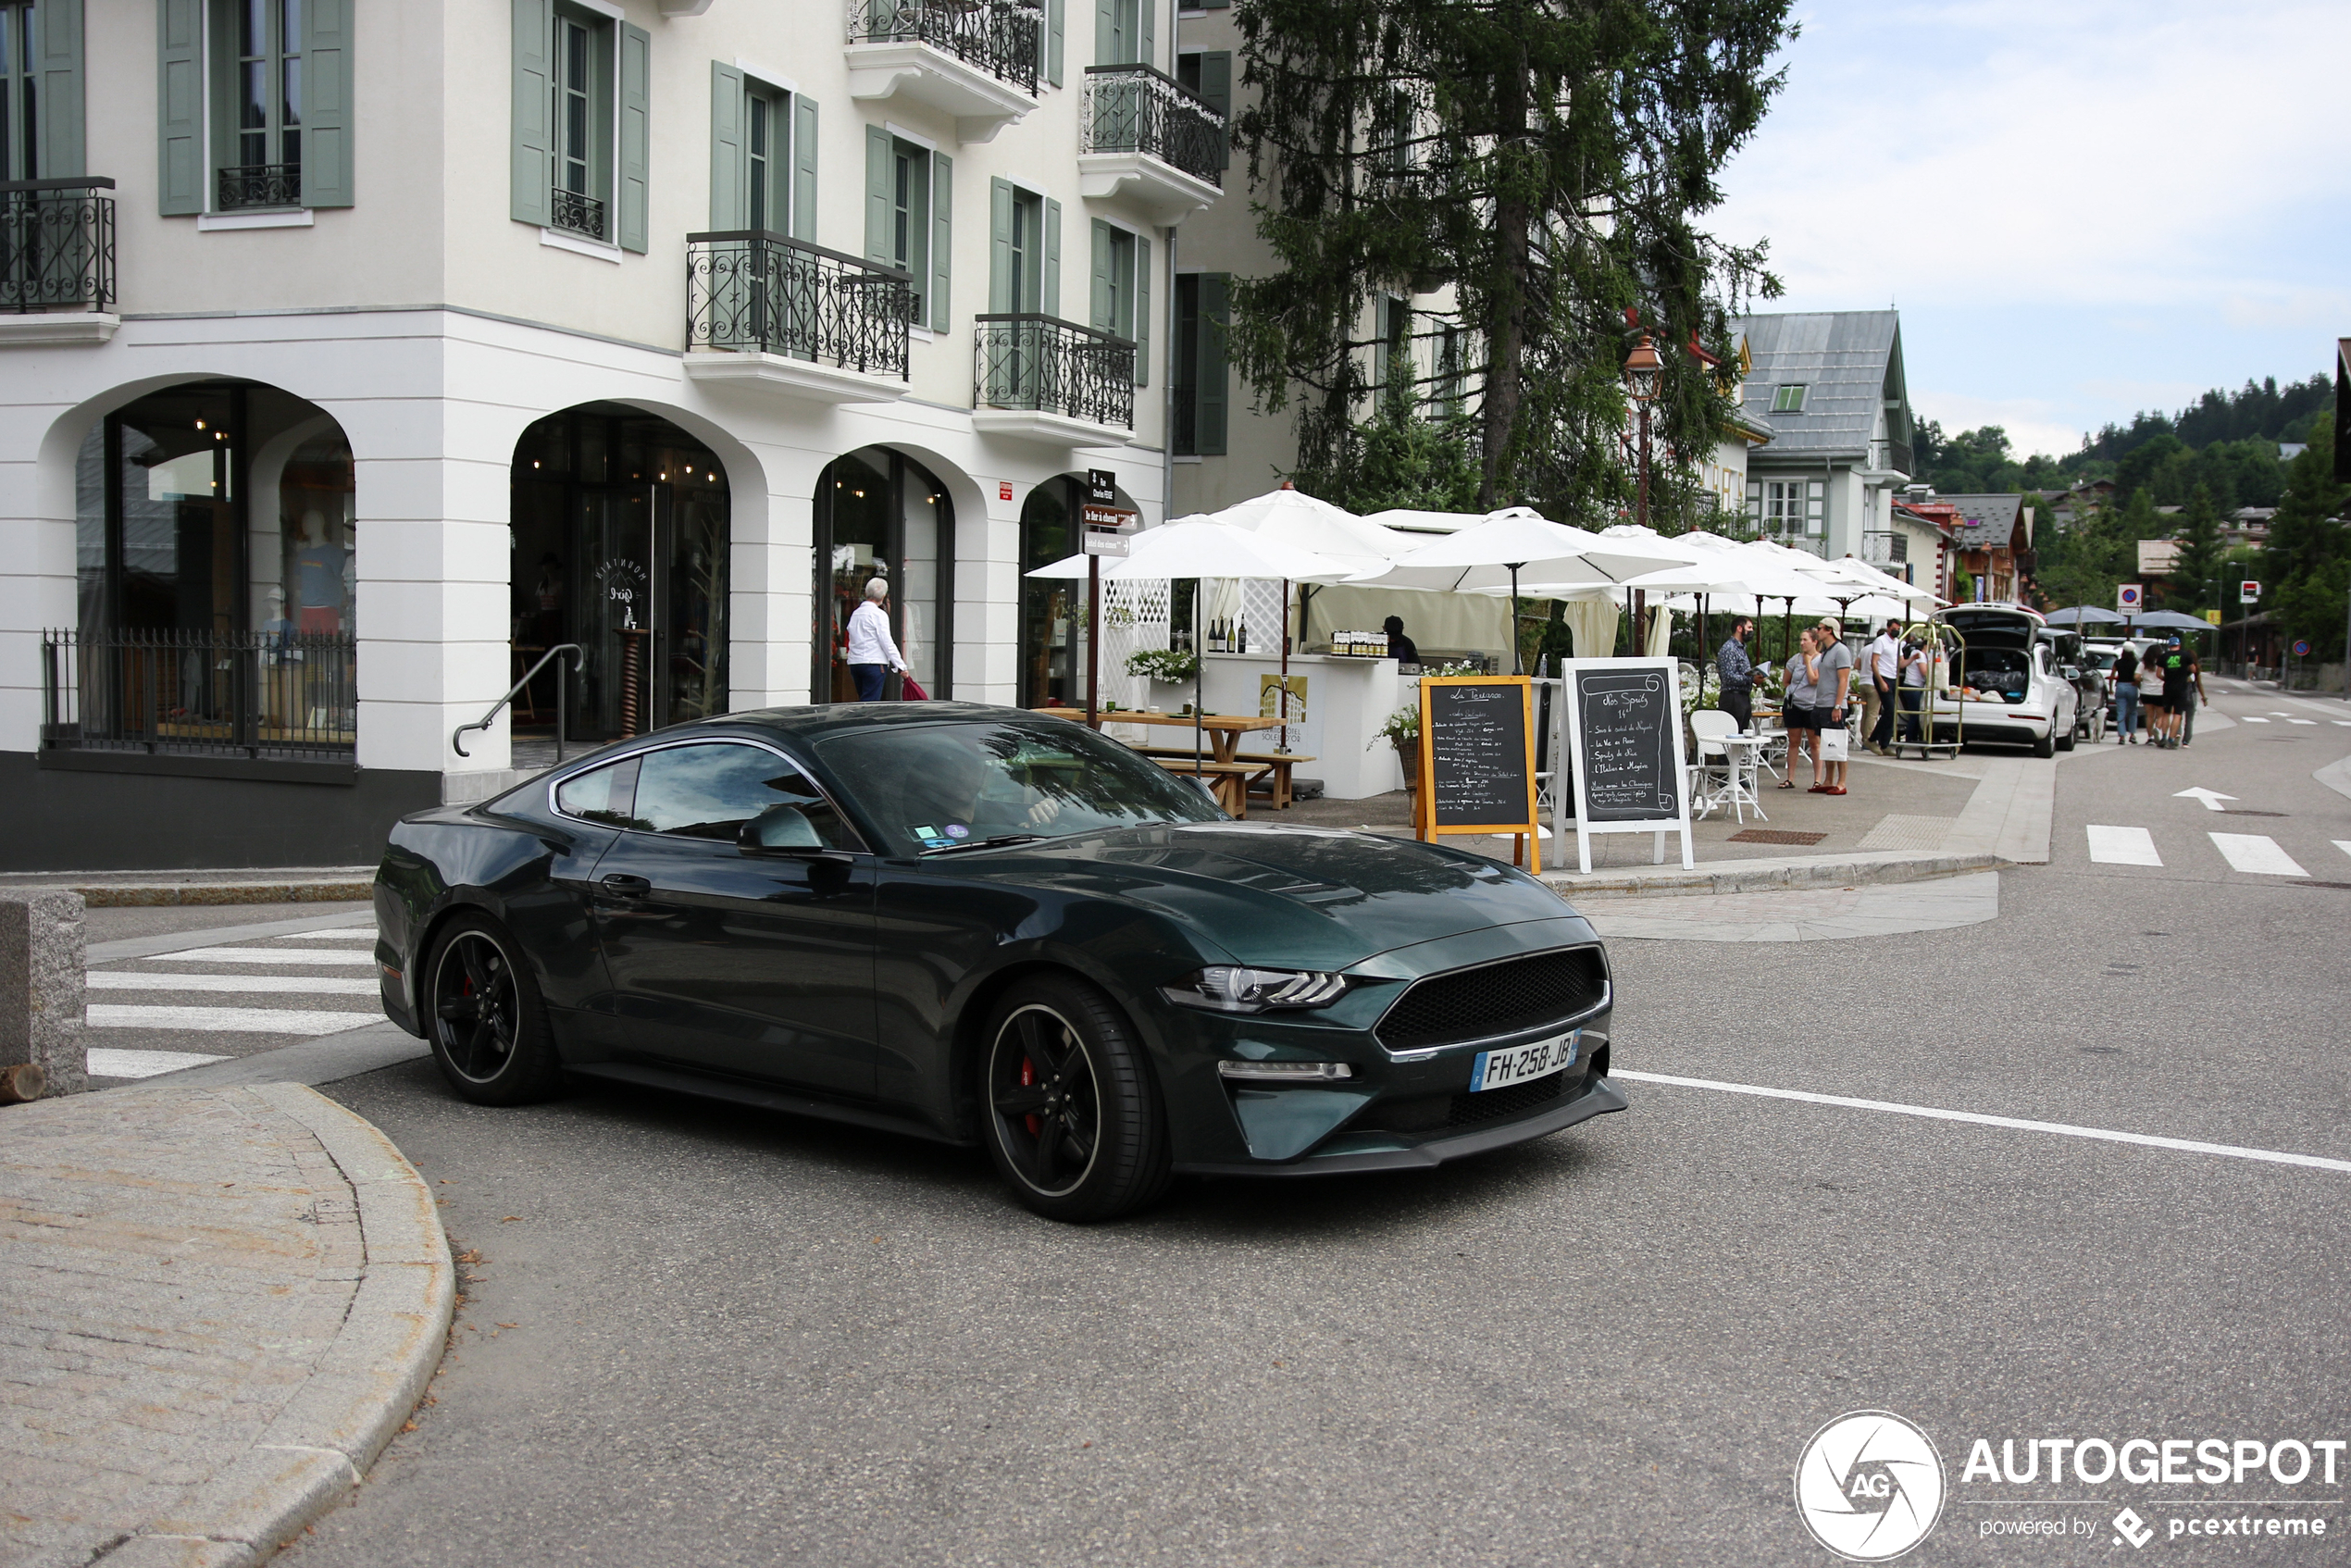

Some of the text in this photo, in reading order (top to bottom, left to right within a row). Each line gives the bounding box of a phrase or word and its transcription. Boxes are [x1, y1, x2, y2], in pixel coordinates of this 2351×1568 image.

[1093, 488, 1104, 498] Charles
[1086, 510, 1090, 521] le
[1103, 512, 1118, 524] cheval
[1086, 539, 1097, 548] hôtel
[1450, 688, 1465, 700] La
[1603, 693, 1619, 706] Nos
